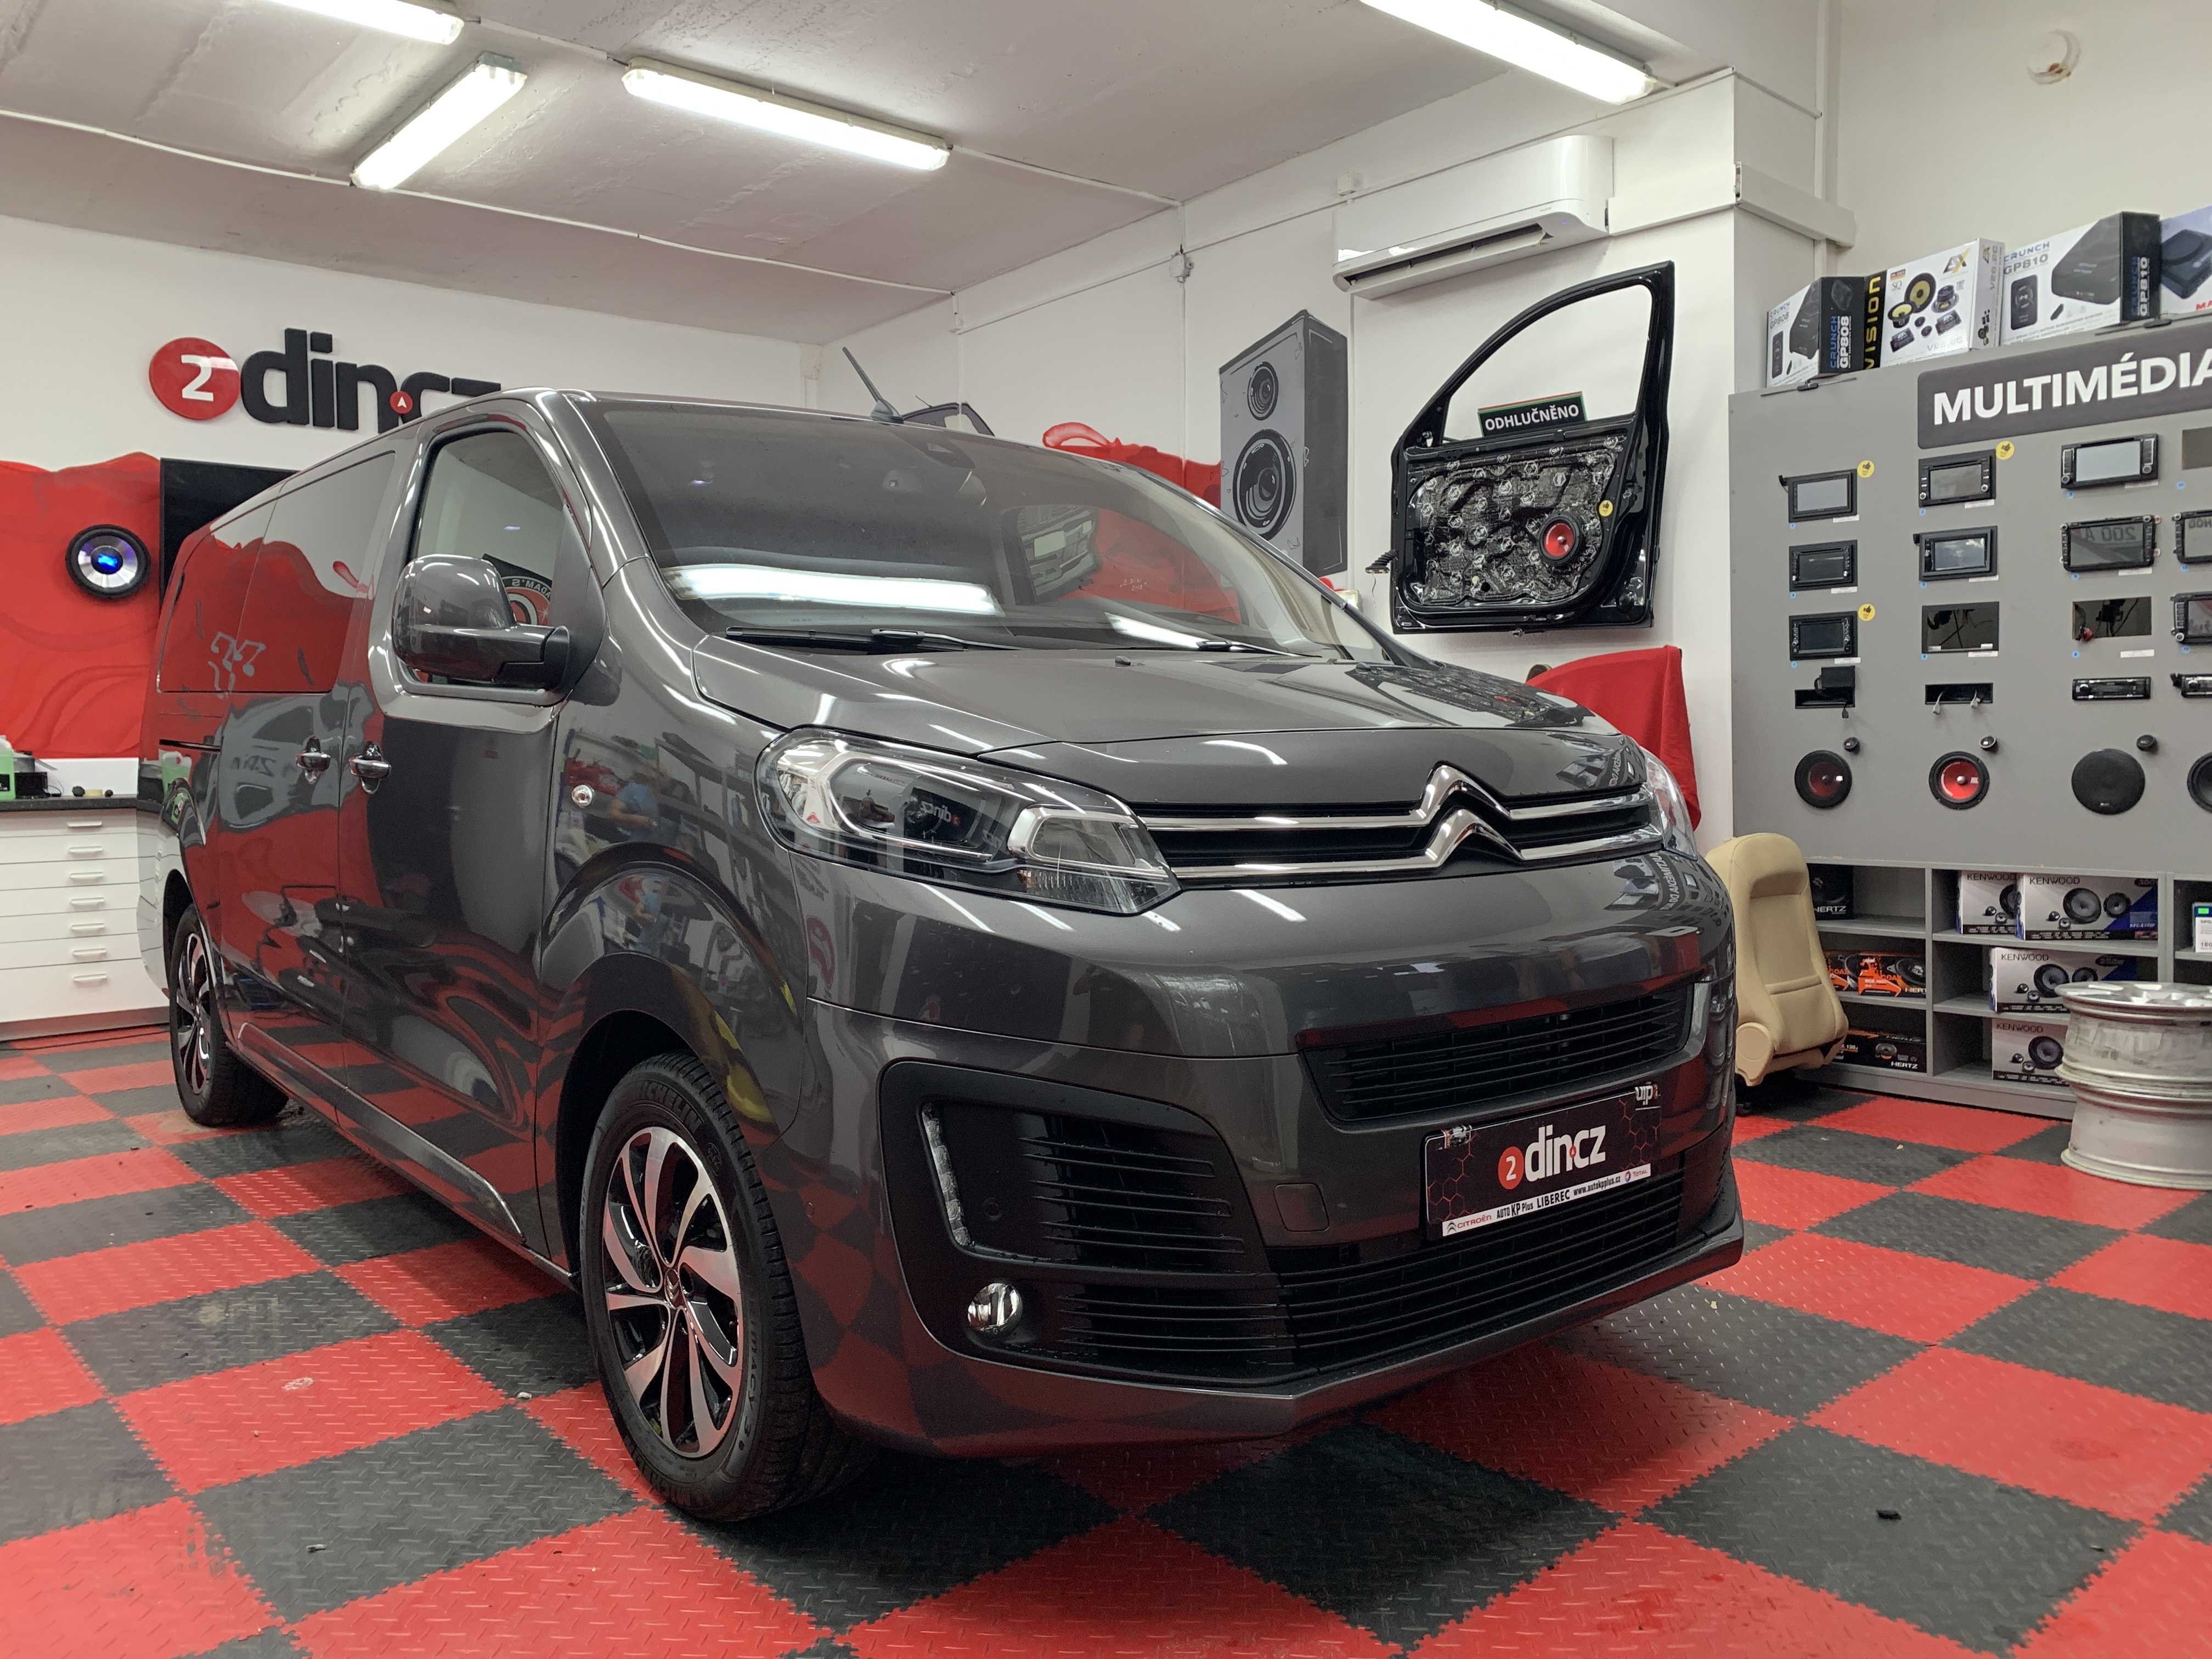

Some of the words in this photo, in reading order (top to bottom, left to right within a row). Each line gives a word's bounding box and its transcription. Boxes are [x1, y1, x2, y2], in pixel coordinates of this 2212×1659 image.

[2004, 241, 2050, 262] CRUNCH
[2004, 253, 2049, 275] GP810
[2140, 257, 2148, 317] GP810
[1840, 315, 1849, 369] GP808
[1934, 347, 2212, 425] MULTIMÉDIA
[1485, 404, 1579, 431] ODHLUČNĚNO
[1967, 873, 2017, 881] KENWOOD
[2029, 877, 2080, 885] KENWOOD
[1996, 1022, 2044, 1034] KENWOOD
[1891, 1061, 1918, 1069] HERTZ
[1497, 1207, 1511, 1219] AUTO
[1511, 1203, 1521, 1217] KP
[1522, 1201, 1534, 1212] Plus
[1537, 1189, 1570, 1208] LIBEREC
[1573, 1175, 1621, 1196] www.autokpplus.cz
